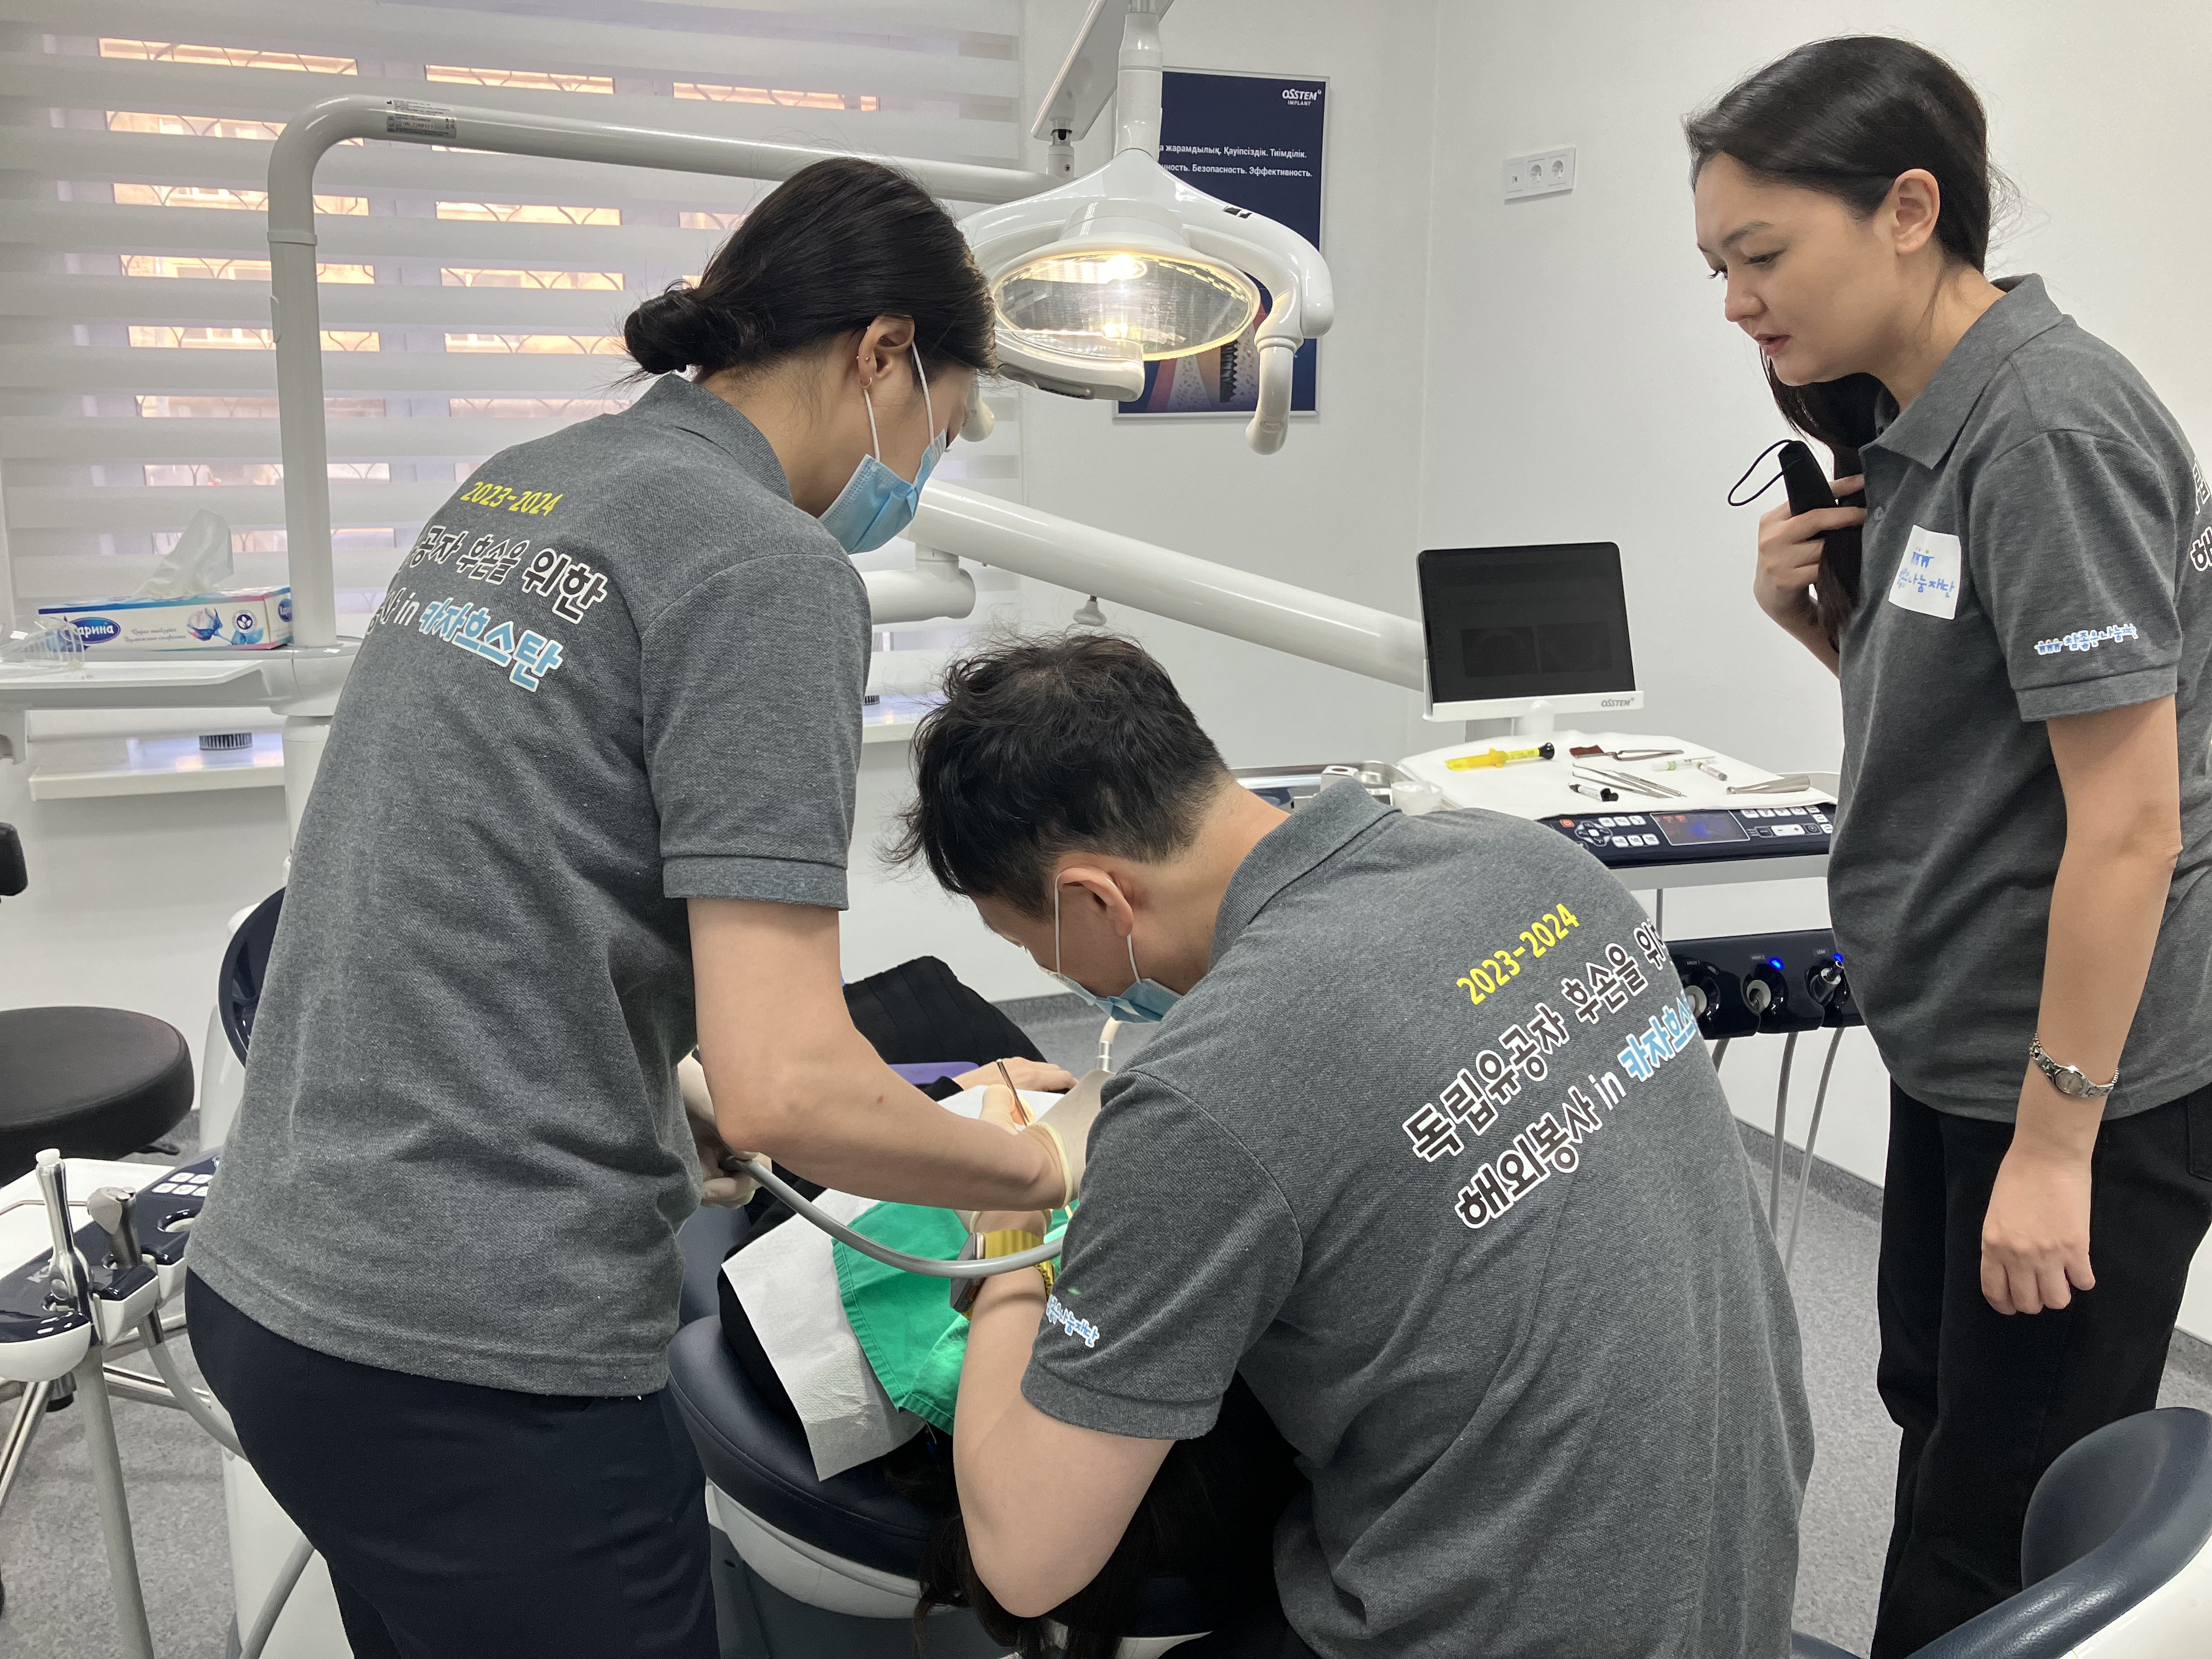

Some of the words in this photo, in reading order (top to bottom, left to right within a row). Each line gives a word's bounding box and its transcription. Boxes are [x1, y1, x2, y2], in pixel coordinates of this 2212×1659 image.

[1282, 88, 1317, 101] OSSTEM
[1223, 146, 1268, 157] Қауіпсіздік.
[1270, 148, 1307, 159] Тиімділік.
[1192, 163, 1247, 174] Безопасность.
[1249, 166, 1313, 178] Эффективность.
[460, 481, 563, 516] 2023-2024
[456, 533, 530, 585] 후손을
[522, 548, 608, 624] 위한
[76, 624, 115, 639] арина
[393, 591, 421, 627] in
[418, 597, 563, 692] 카자흐스탄
[1601, 699, 1630, 707] OSSTEM
[1455, 902, 1579, 1005] 2023-2024
[1402, 1002, 1570, 1163] 독립유공자
[1561, 943, 1647, 1024] 후손을
[1633, 918, 1670, 971] 위
[1454, 1085, 1602, 1229] 해외봉사
[1588, 1071, 1627, 1111] in
[1617, 990, 1701, 1082] 카자흐스
